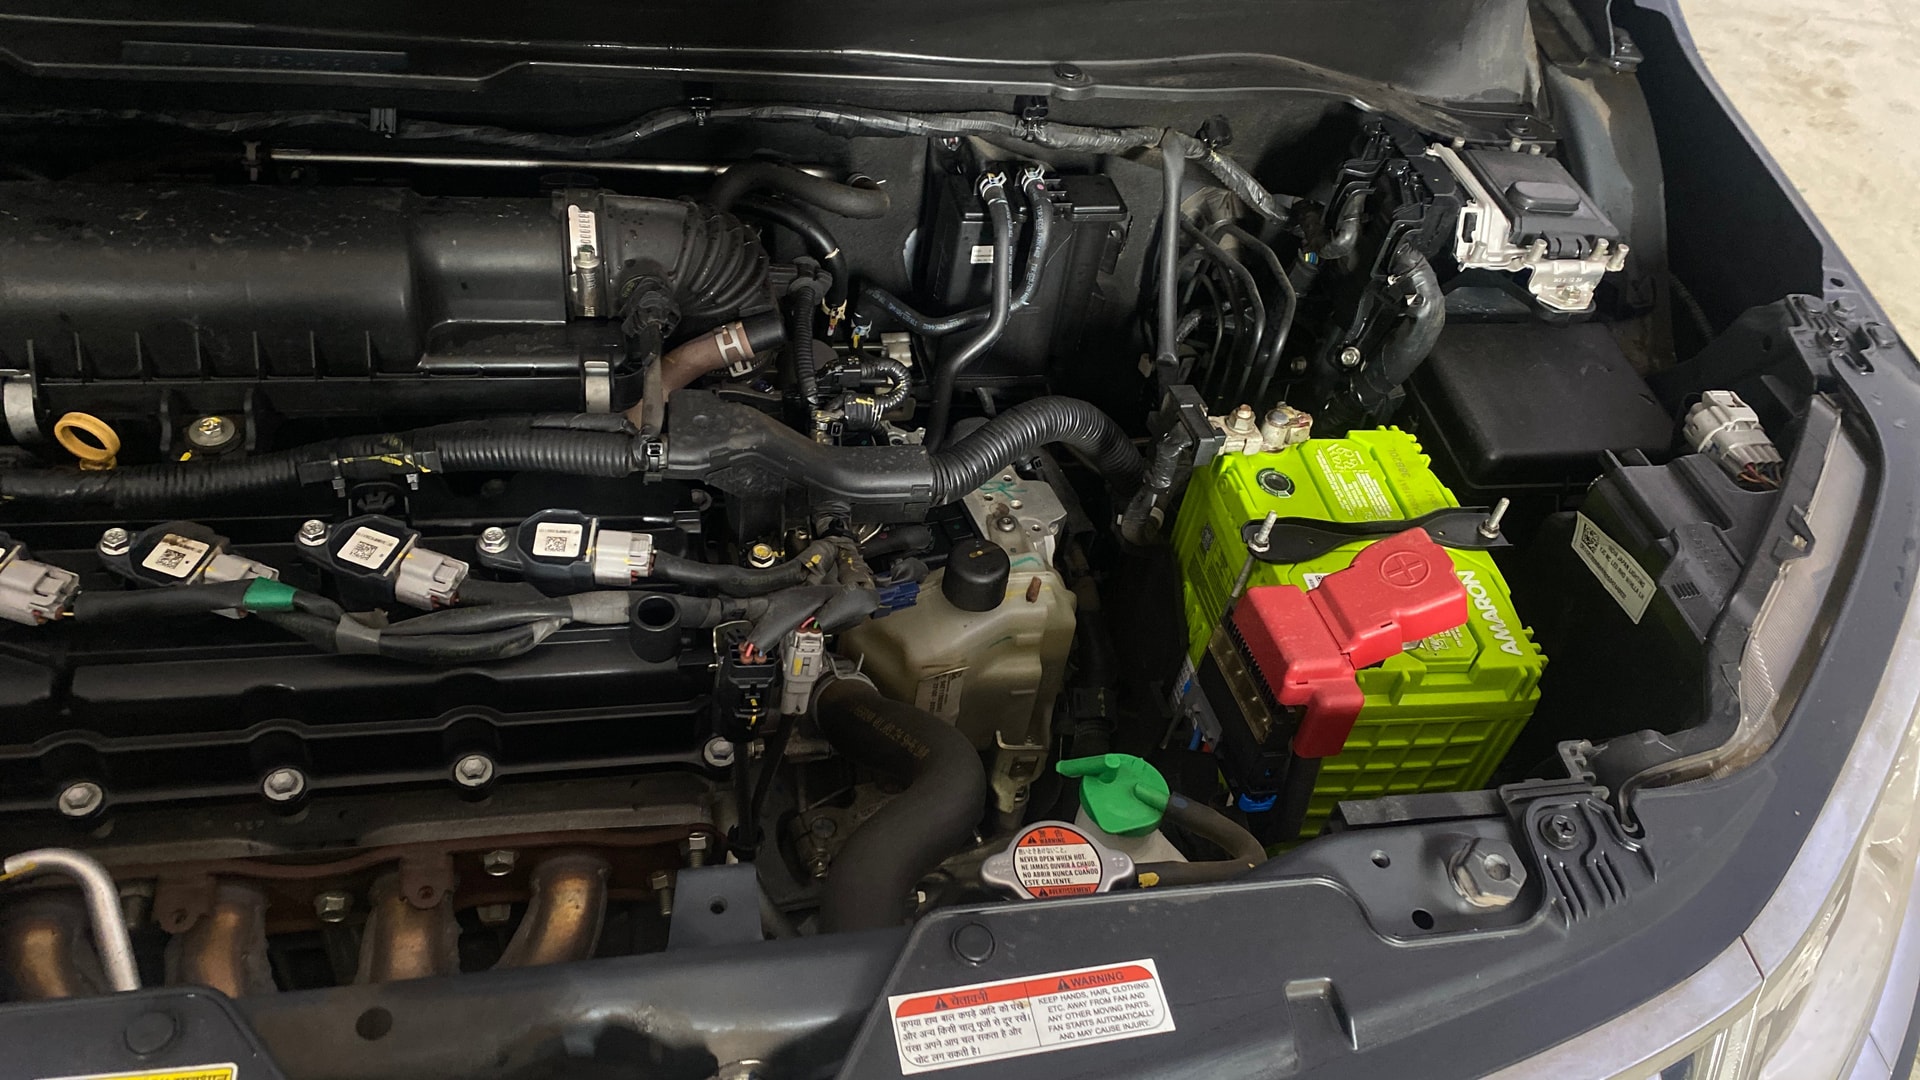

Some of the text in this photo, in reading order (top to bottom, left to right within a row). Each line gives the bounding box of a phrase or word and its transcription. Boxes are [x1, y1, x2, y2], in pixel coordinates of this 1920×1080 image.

[1457, 571, 1523, 656] AMARON
[1039, 837, 1066, 845] WARNING
[1020, 855, 1038, 863] NEVER
[1071, 972, 1124, 987] WARNING
[951, 989, 988, 1006] चेतावनी
[1037, 982, 1150, 1005] KEEP HANDS, HAIR, CLOTHING
[1047, 992, 1145, 1013] ETC. AWAY FROM FAN AND
[900, 1018, 922, 1032] कृपया
[941, 1013, 955, 1023] बाल
[958, 1009, 977, 1021] कपड़े
[979, 1006, 996, 1016] आदि
[999, 1004, 1009, 1014] को
[1047, 1014, 1063, 1024] ANY
[1065, 1009, 1091, 1020] OTHER
[1093, 1004, 1124, 1016] MOVING
[1048, 1009, 1156, 1033] FAN STARTS AUTOMATICALLY
[903, 1030, 917, 1041] और
[919, 1028, 936, 1039] अन्य
[937, 1023, 957, 1035] किसी
[959, 1022, 977, 1033] चालू
[993, 1016, 1001, 1026] से
[1003, 1015, 1013, 1027] दूर
[1059, 1020, 1151, 1041] AND MAY CAUSE INJURY.
[905, 1040, 922, 1053] पंखा
[924, 1038, 942, 1049] अपने
[944, 1036, 960, 1046] आप
[961, 1034, 975, 1044] चल
[977, 1031, 1000, 1042] सकता
[1008, 1026, 1023, 1037] और
[913, 1053, 930, 1065] चोट
[931, 1051, 945, 1062] लग
[946, 1047, 970, 1060] सकती
